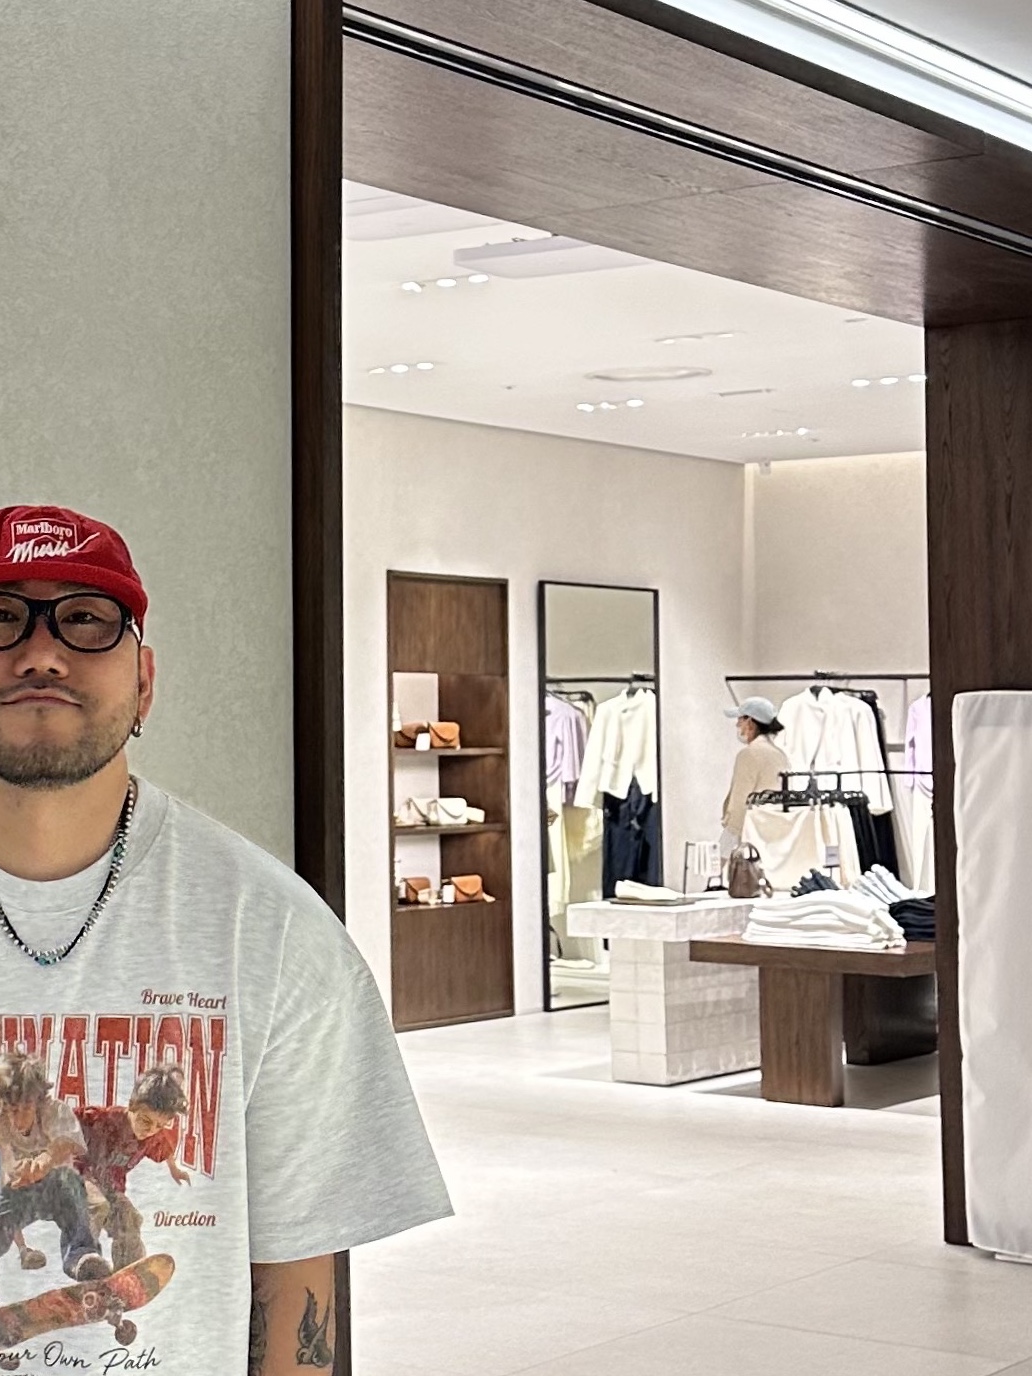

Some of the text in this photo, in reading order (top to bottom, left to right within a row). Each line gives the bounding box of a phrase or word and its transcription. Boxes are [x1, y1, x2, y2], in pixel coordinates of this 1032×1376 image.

[16, 521, 73, 538] Marlboro
[5, 533, 99, 563] Music
[141, 988, 227, 1010] Brave Heart
[153, 1211, 217, 1228] Direction
[43, 1341, 91, 1368] Own
[98, 1347, 162, 1376] Path
